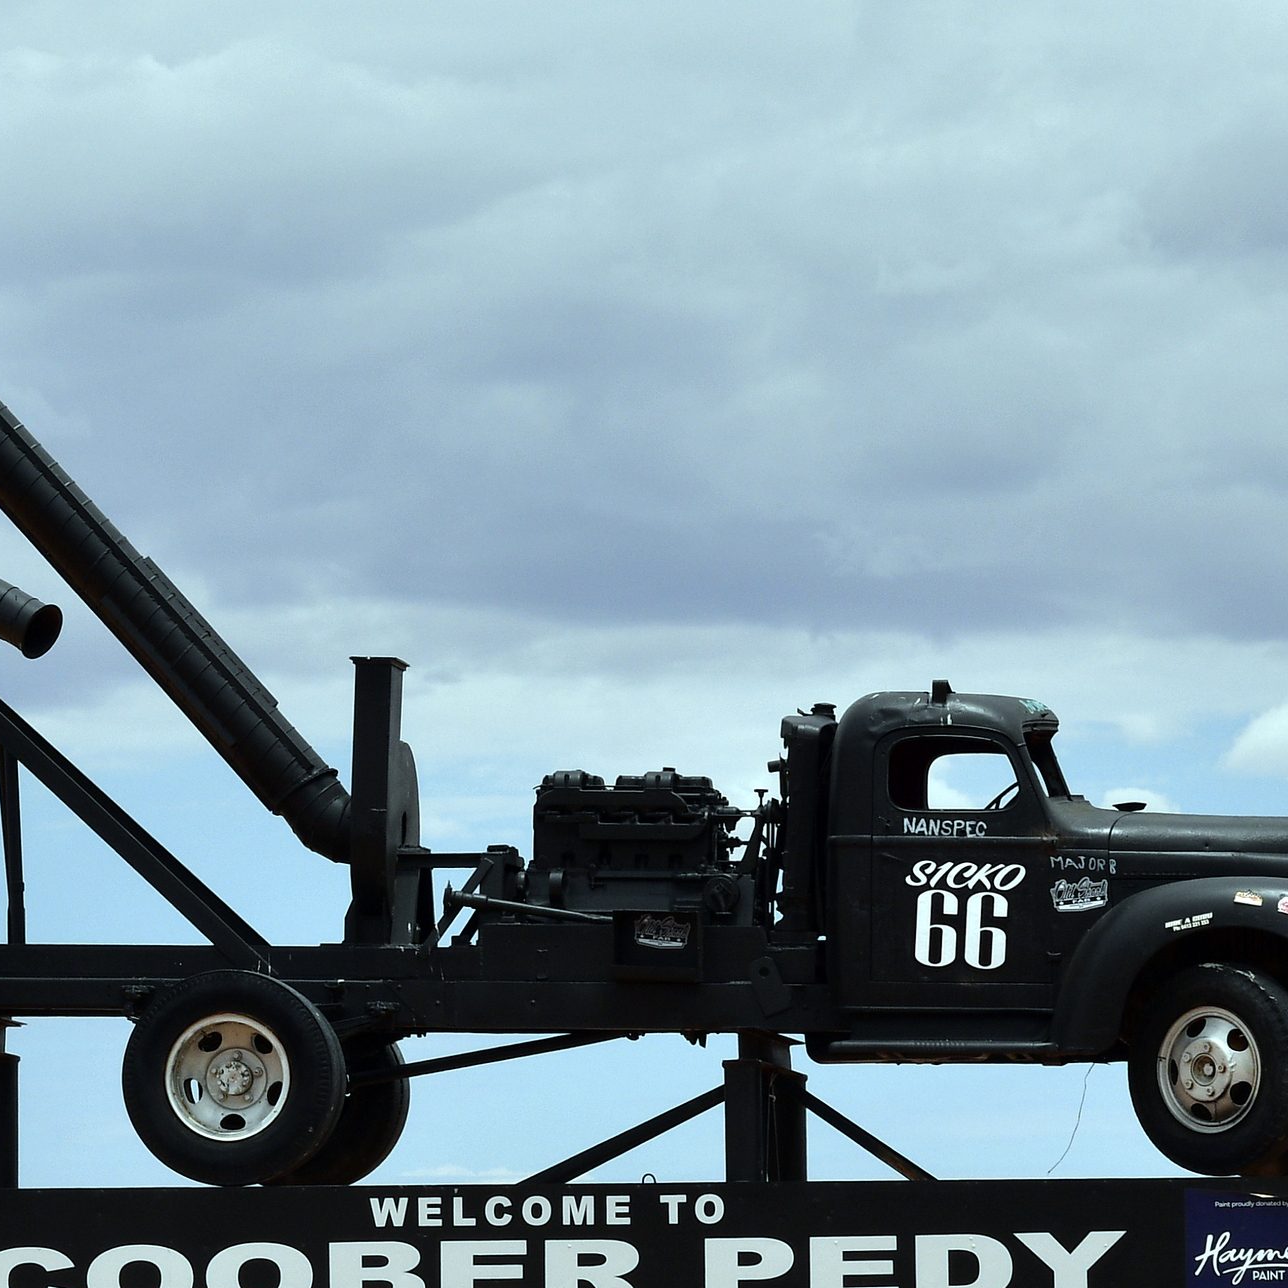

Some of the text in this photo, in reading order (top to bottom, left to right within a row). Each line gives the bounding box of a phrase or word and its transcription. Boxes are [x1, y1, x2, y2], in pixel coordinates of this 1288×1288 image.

[903, 817, 987, 837] NANSPEC
[1050, 856, 1106, 871] MAJOR
[915, 889, 1008, 970] 66
[370, 1194, 726, 1228] WELCOME TO
[1253, 1270, 1285, 1281] PAINT
